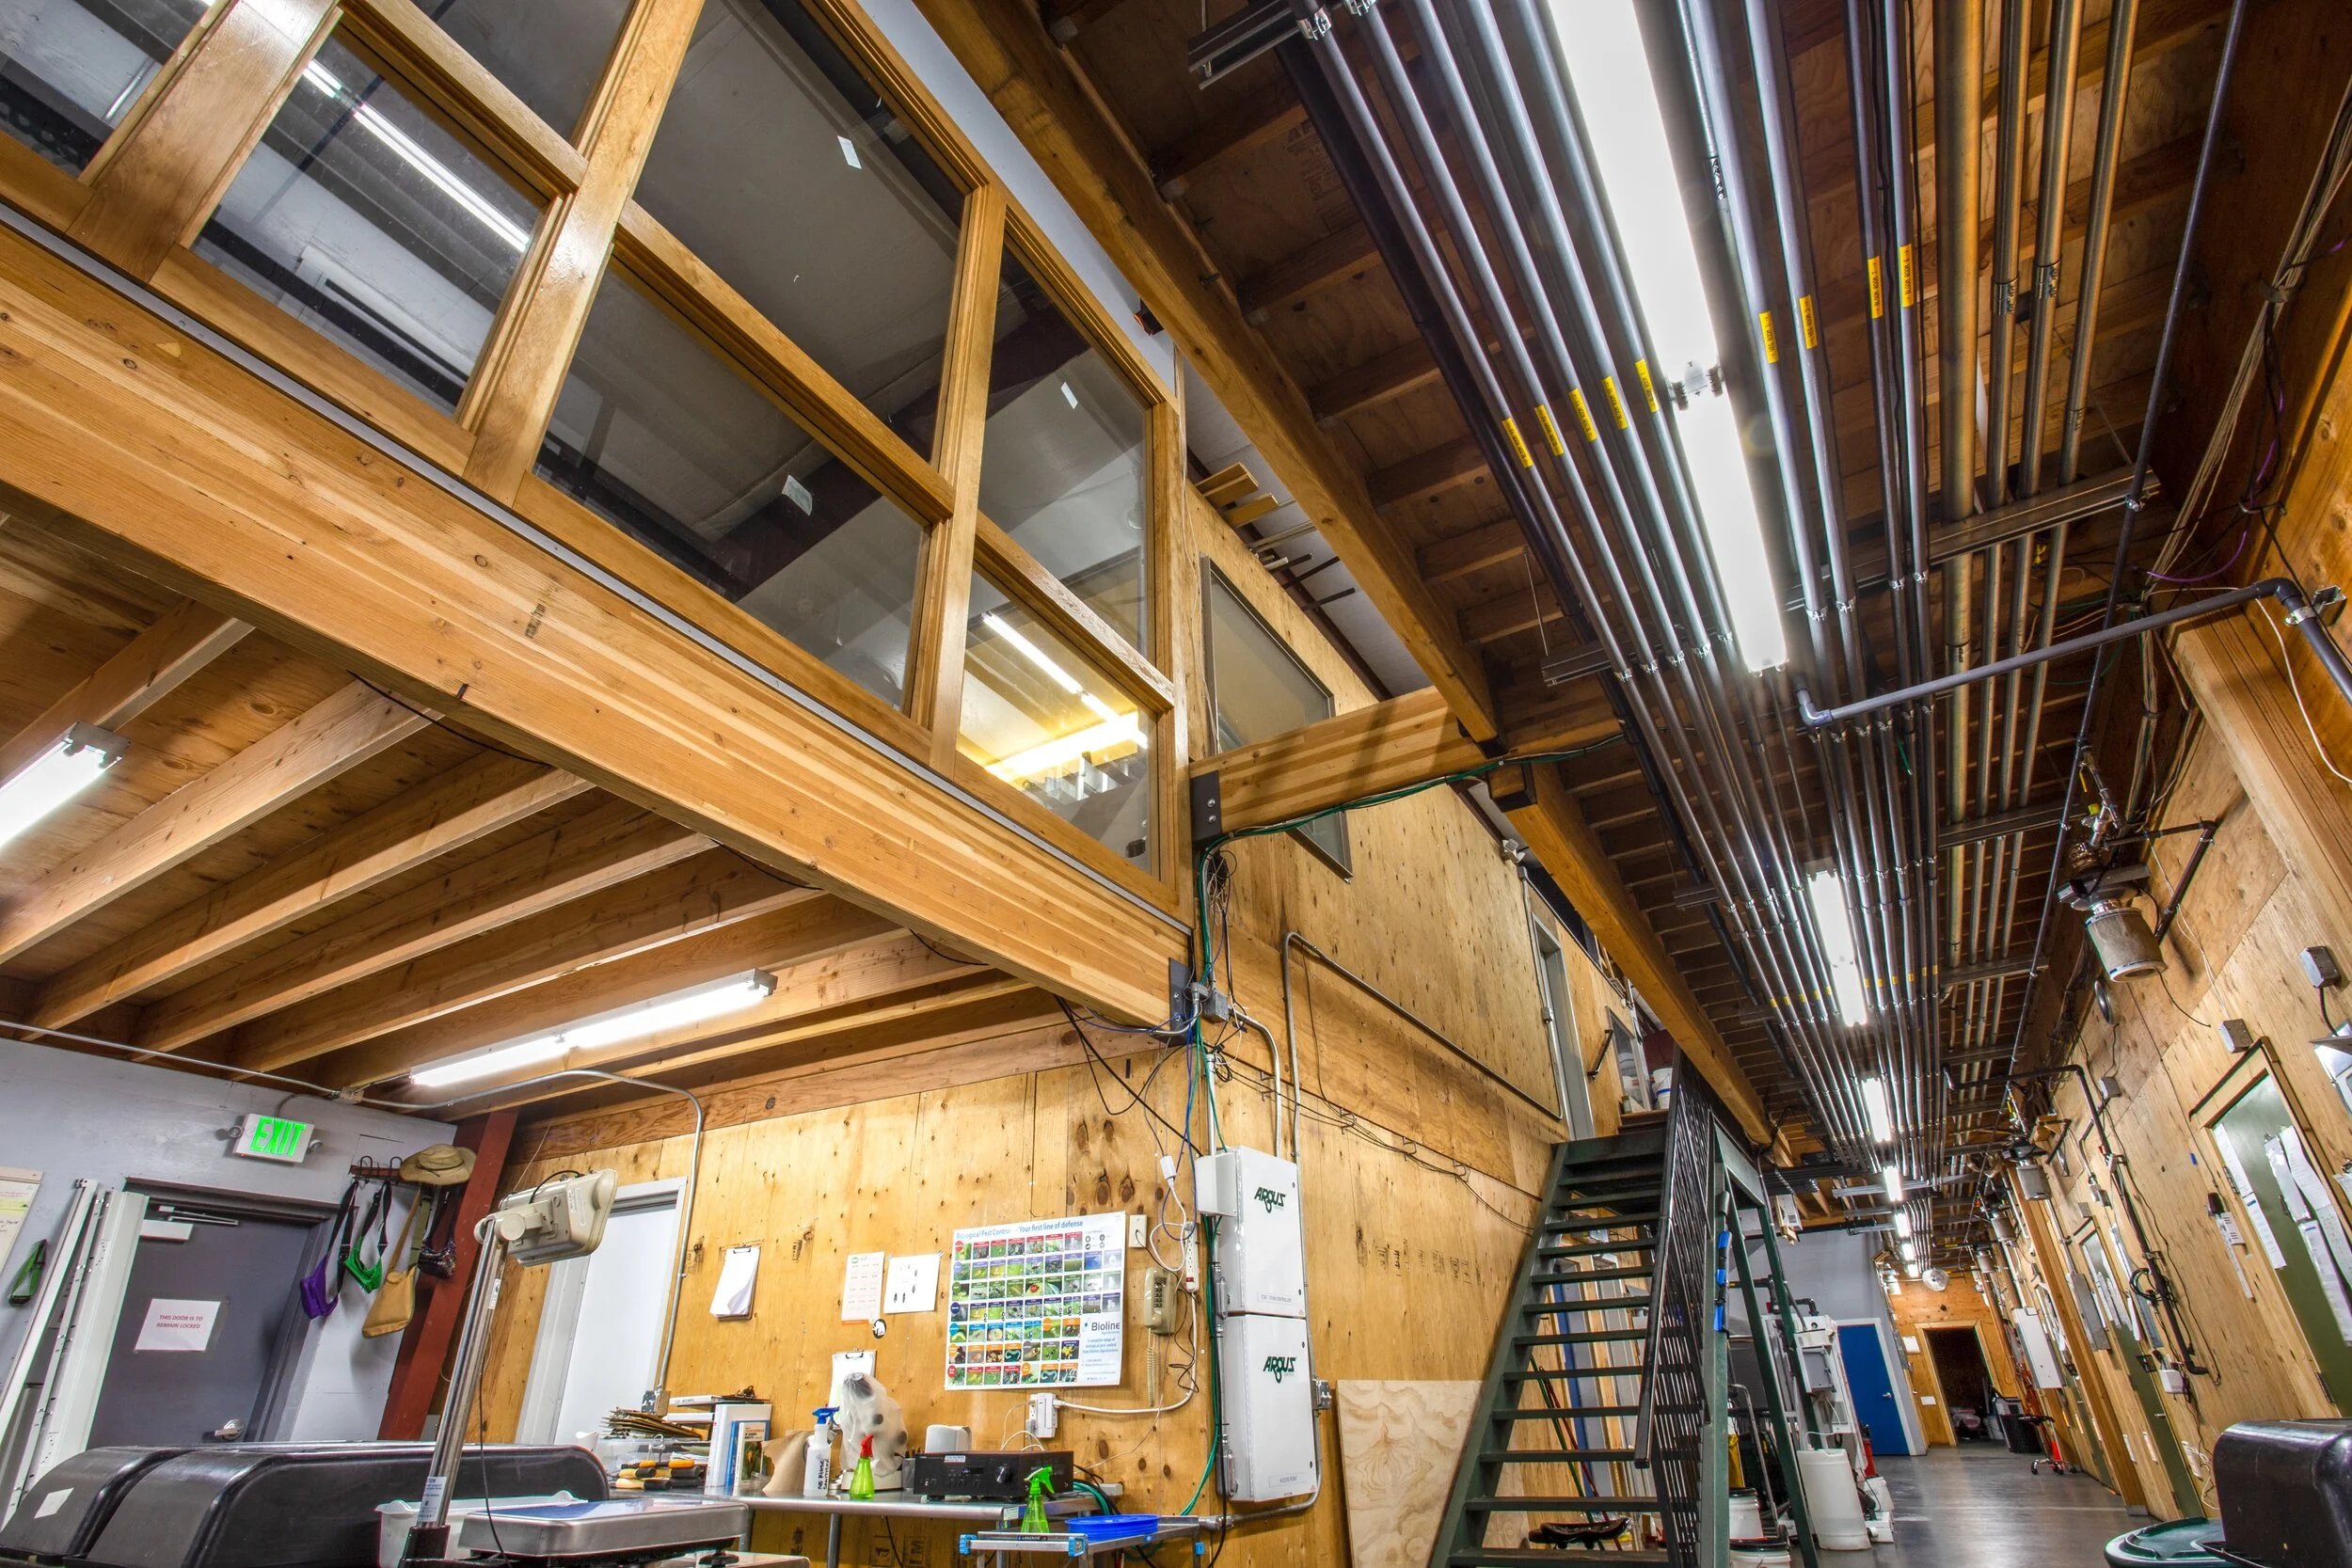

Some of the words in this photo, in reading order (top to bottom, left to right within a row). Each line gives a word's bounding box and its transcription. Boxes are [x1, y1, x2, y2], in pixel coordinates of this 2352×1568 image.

[250, 1117, 307, 1158] EXIT
[1254, 1186, 1286, 1213] ARGUS
[956, 1231, 980, 1240] Biological
[980, 1228, 993, 1237] Pest
[993, 1227, 1011, 1236] Control
[1019, 1225, 1031, 1234] Your
[1060, 1220, 1084, 1228] defense
[1091, 1321, 1120, 1331] Bioline
[1263, 1356, 1295, 1384] ARGUS
